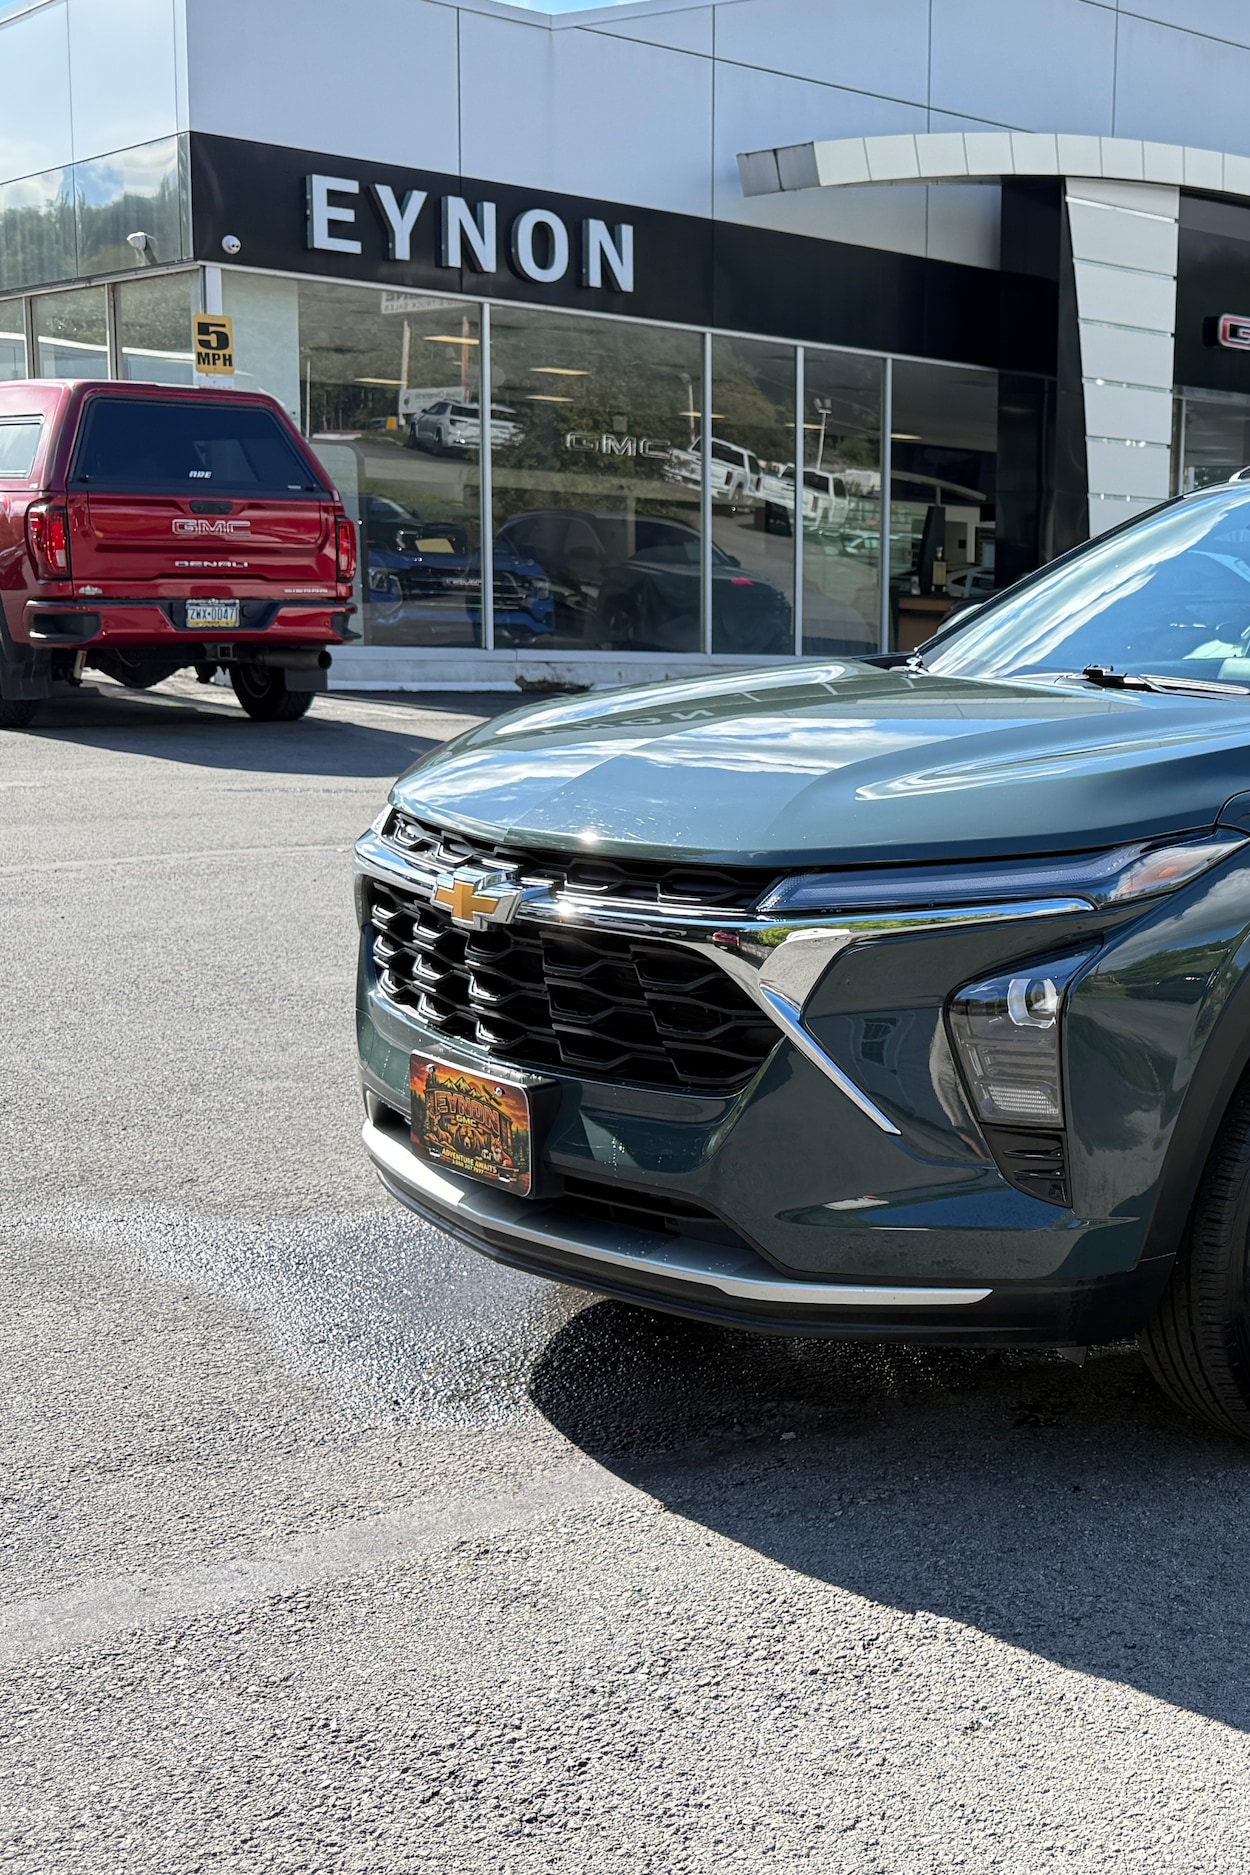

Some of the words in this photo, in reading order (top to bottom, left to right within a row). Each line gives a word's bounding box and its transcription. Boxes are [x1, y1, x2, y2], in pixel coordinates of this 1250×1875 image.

[306, 174, 634, 293] EYNON
[197, 321, 230, 351] 5
[197, 351, 233, 367] MPH
[566, 432, 672, 459] GMC
[171, 519, 251, 537] GMC
[174, 560, 249, 568] DENALI
[434, 1090, 500, 1136] EYNON
[456, 1114, 477, 1128] GMC
[441, 1148, 474, 1166] ADVENTURE
[475, 1160, 498, 1174] AWAITS
